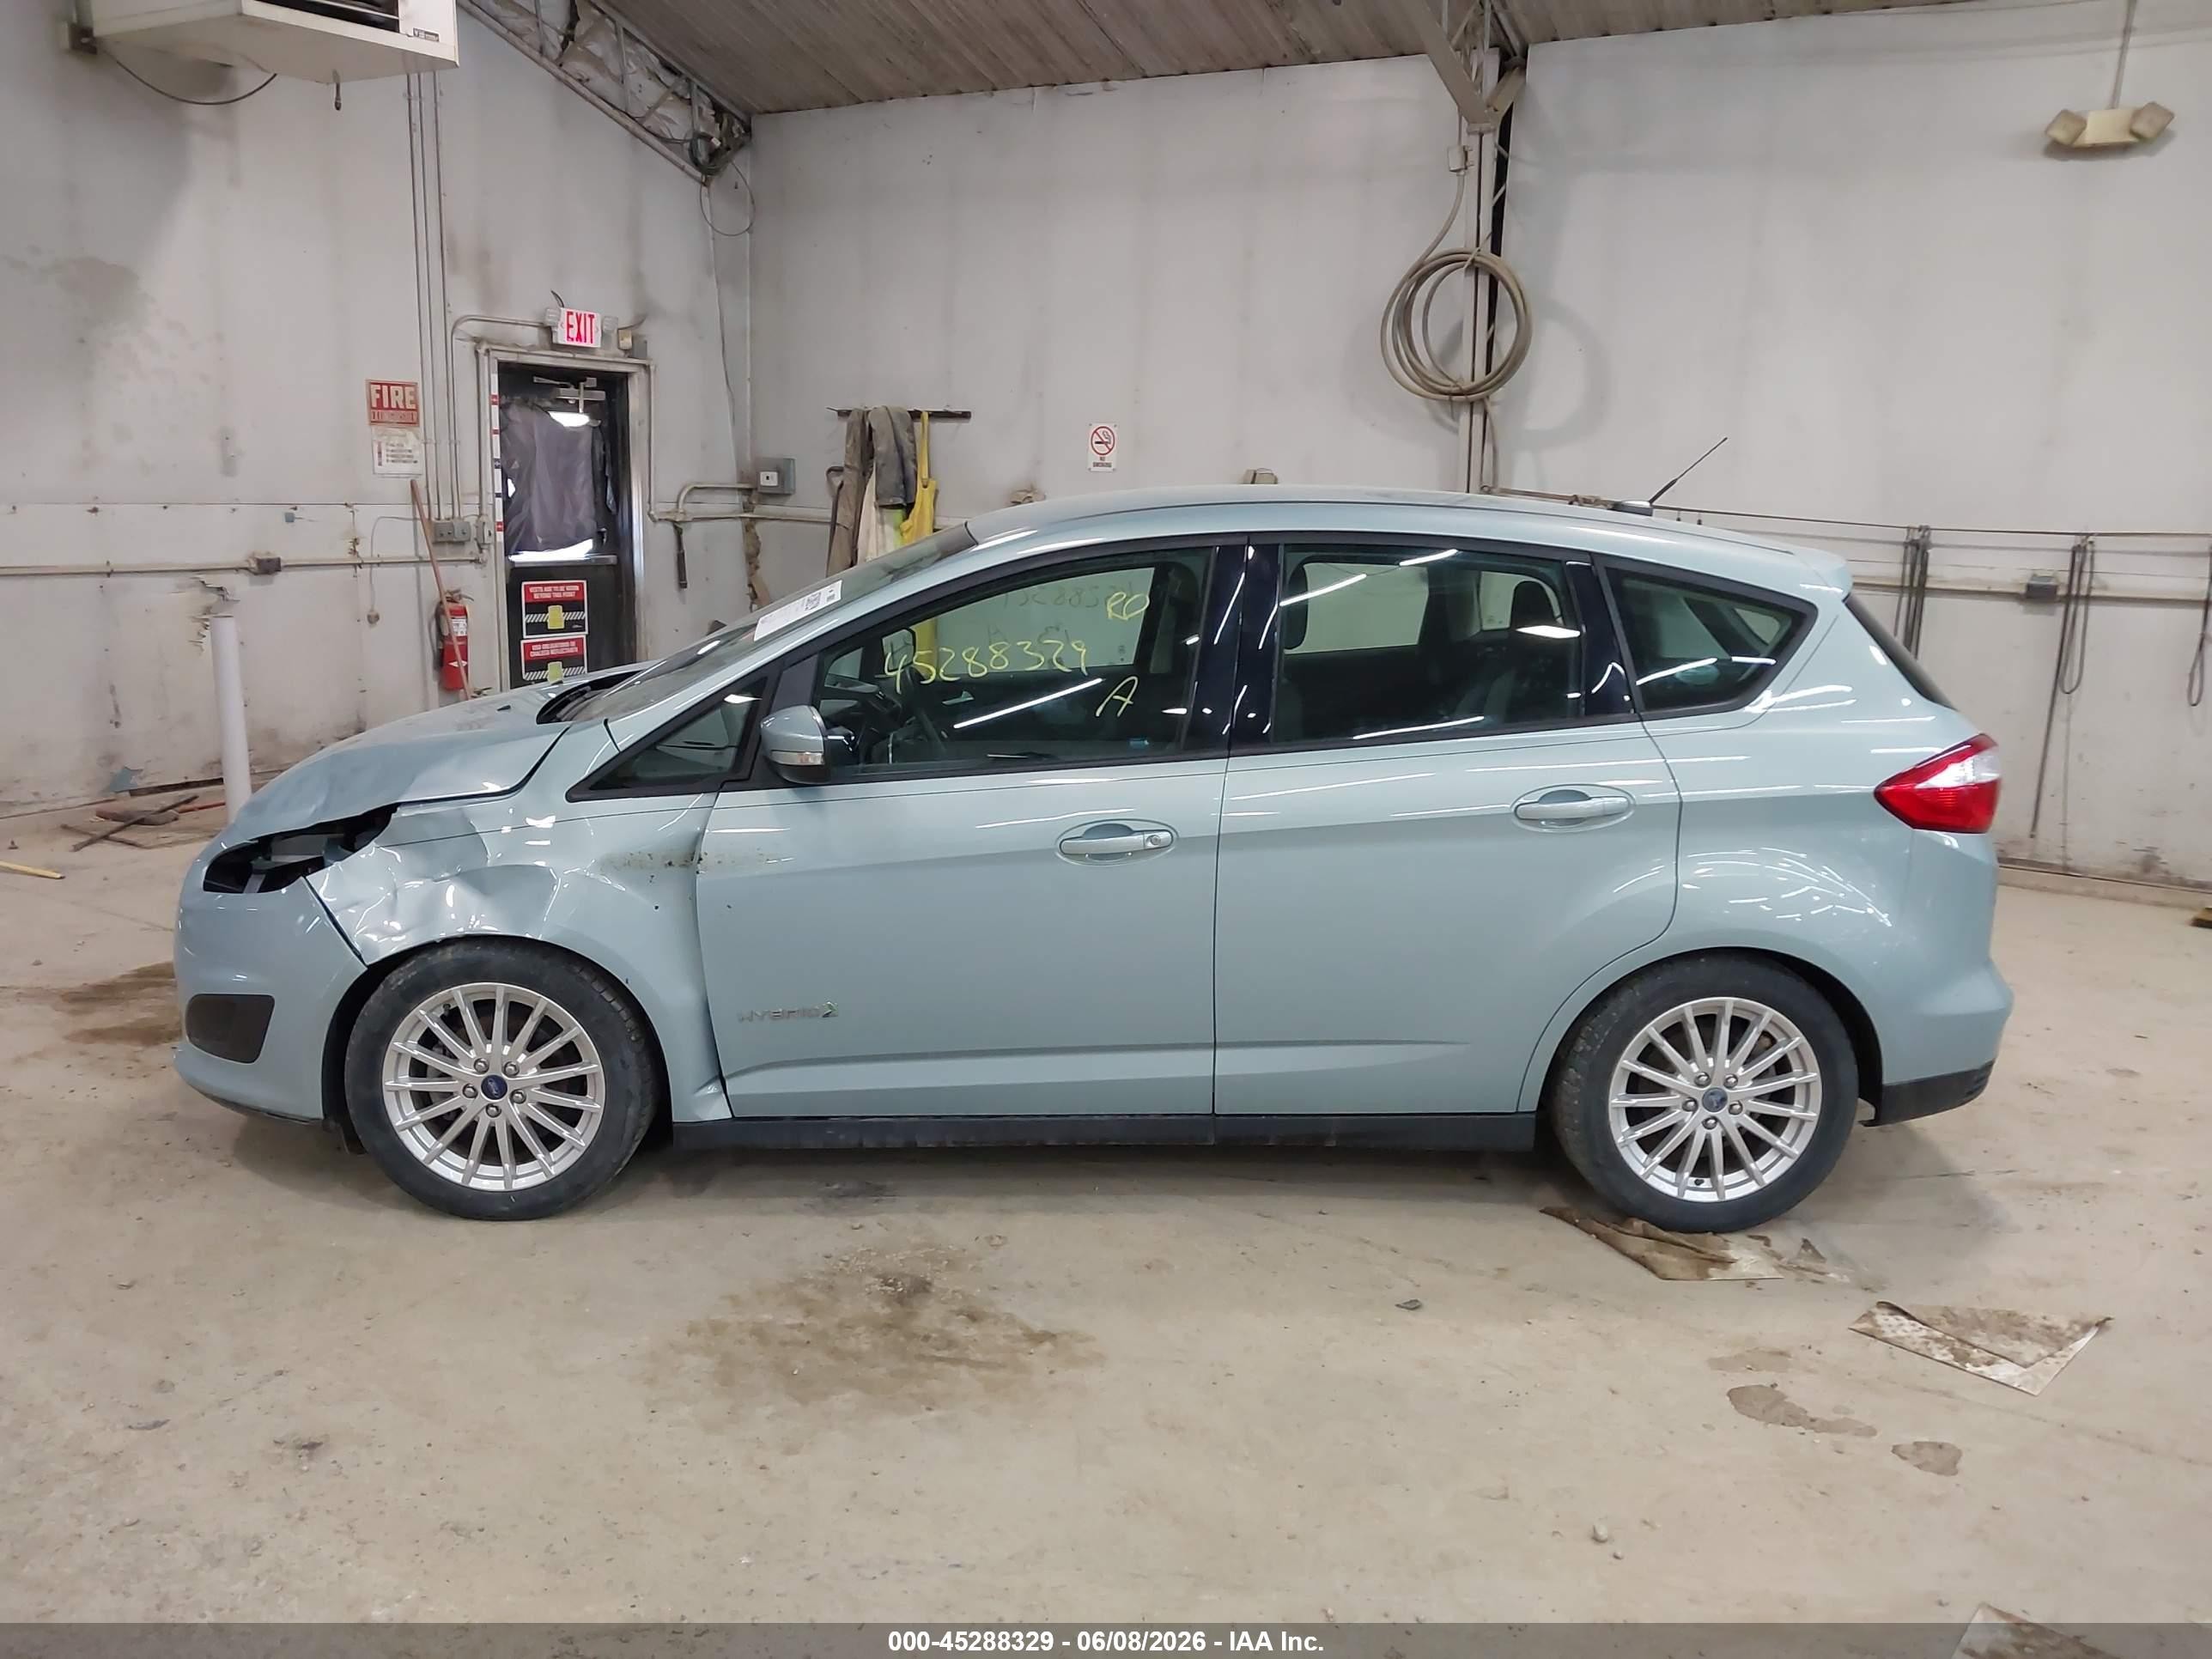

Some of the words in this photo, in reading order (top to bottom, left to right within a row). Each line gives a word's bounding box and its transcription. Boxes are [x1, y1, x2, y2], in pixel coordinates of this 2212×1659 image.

[566, 310, 595, 344] EXIT
[370, 384, 416, 409] FIRE
[884, 639, 1088, 695] 45288329
[1095, 676, 1139, 718] A
